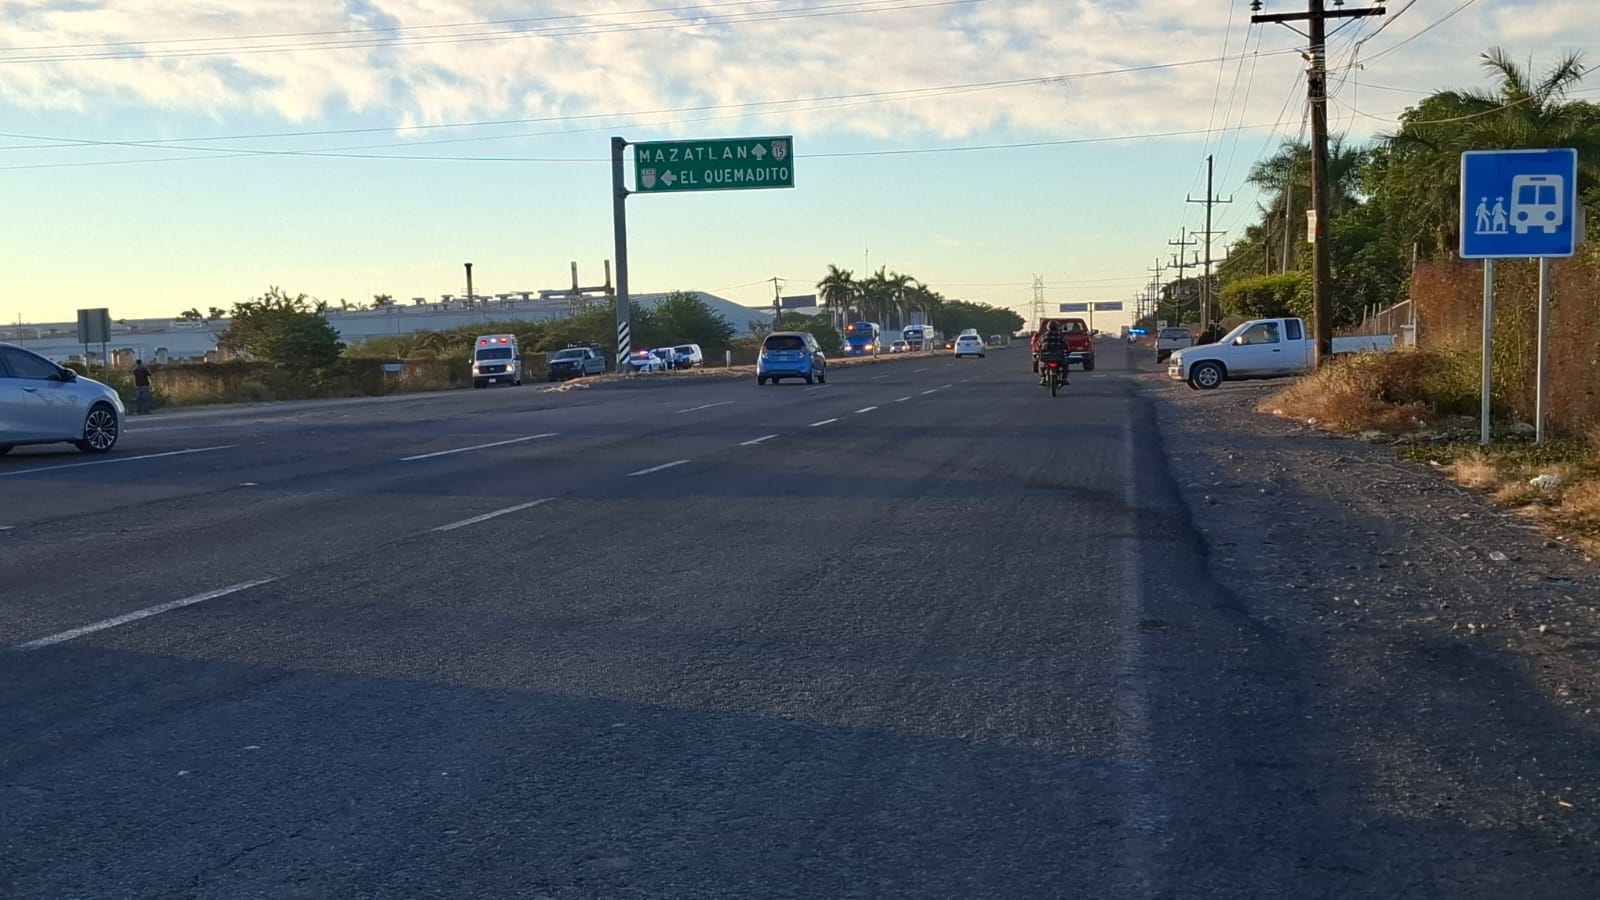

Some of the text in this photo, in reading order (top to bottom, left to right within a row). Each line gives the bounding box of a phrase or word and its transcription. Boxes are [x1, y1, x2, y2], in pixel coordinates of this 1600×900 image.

[639, 146, 747, 163] MAZATLAN
[680, 167, 788, 184] EL QUEMADITO
